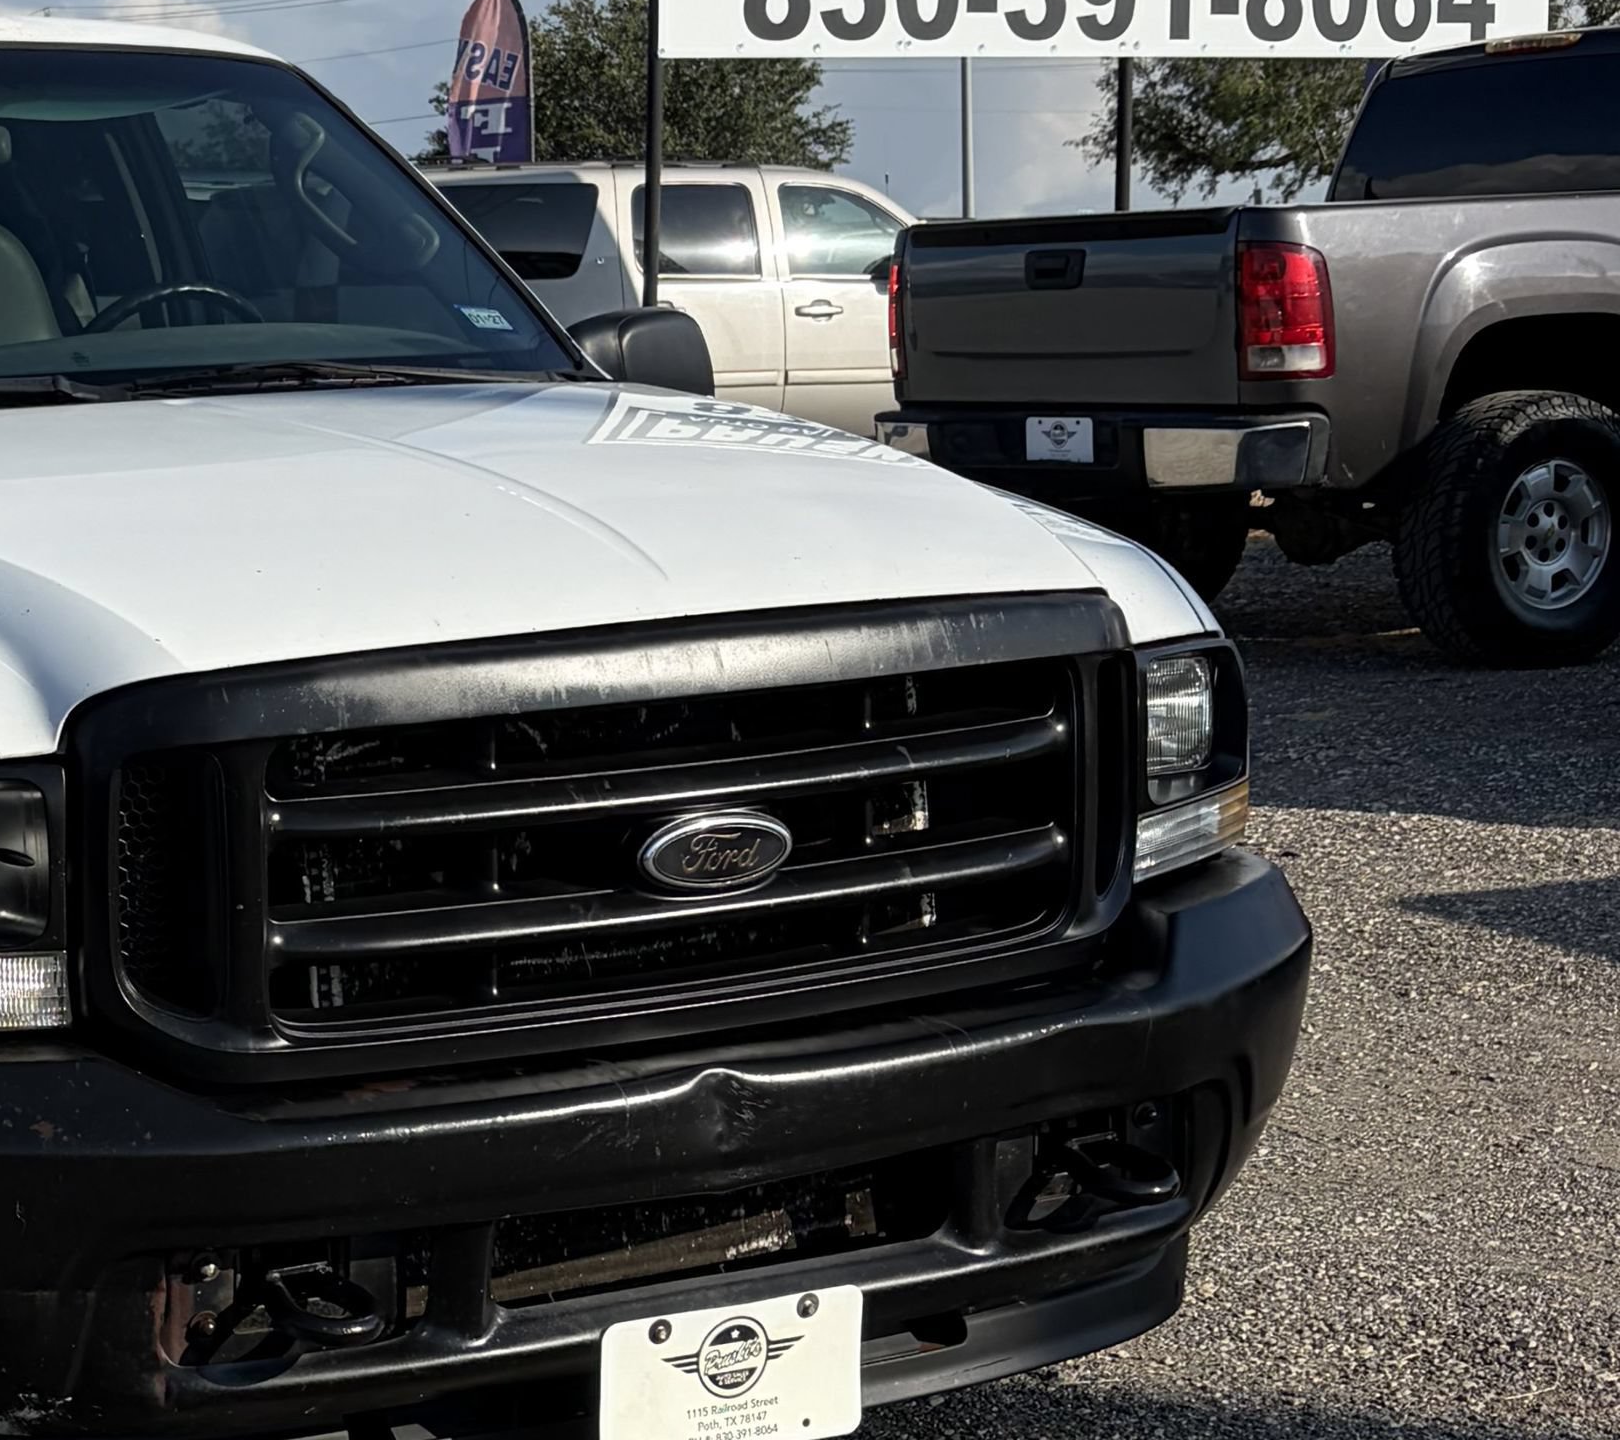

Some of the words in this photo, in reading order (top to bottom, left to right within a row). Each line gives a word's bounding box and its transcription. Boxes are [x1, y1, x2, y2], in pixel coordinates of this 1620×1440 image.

[681, 832, 762, 874] Ford
[686, 1406, 709, 1420] 1115
[710, 1400, 748, 1415] Railroad
[750, 1396, 779, 1409] Street
[724, 1415, 738, 1427] TX
[739, 1410, 768, 1425] 78147
